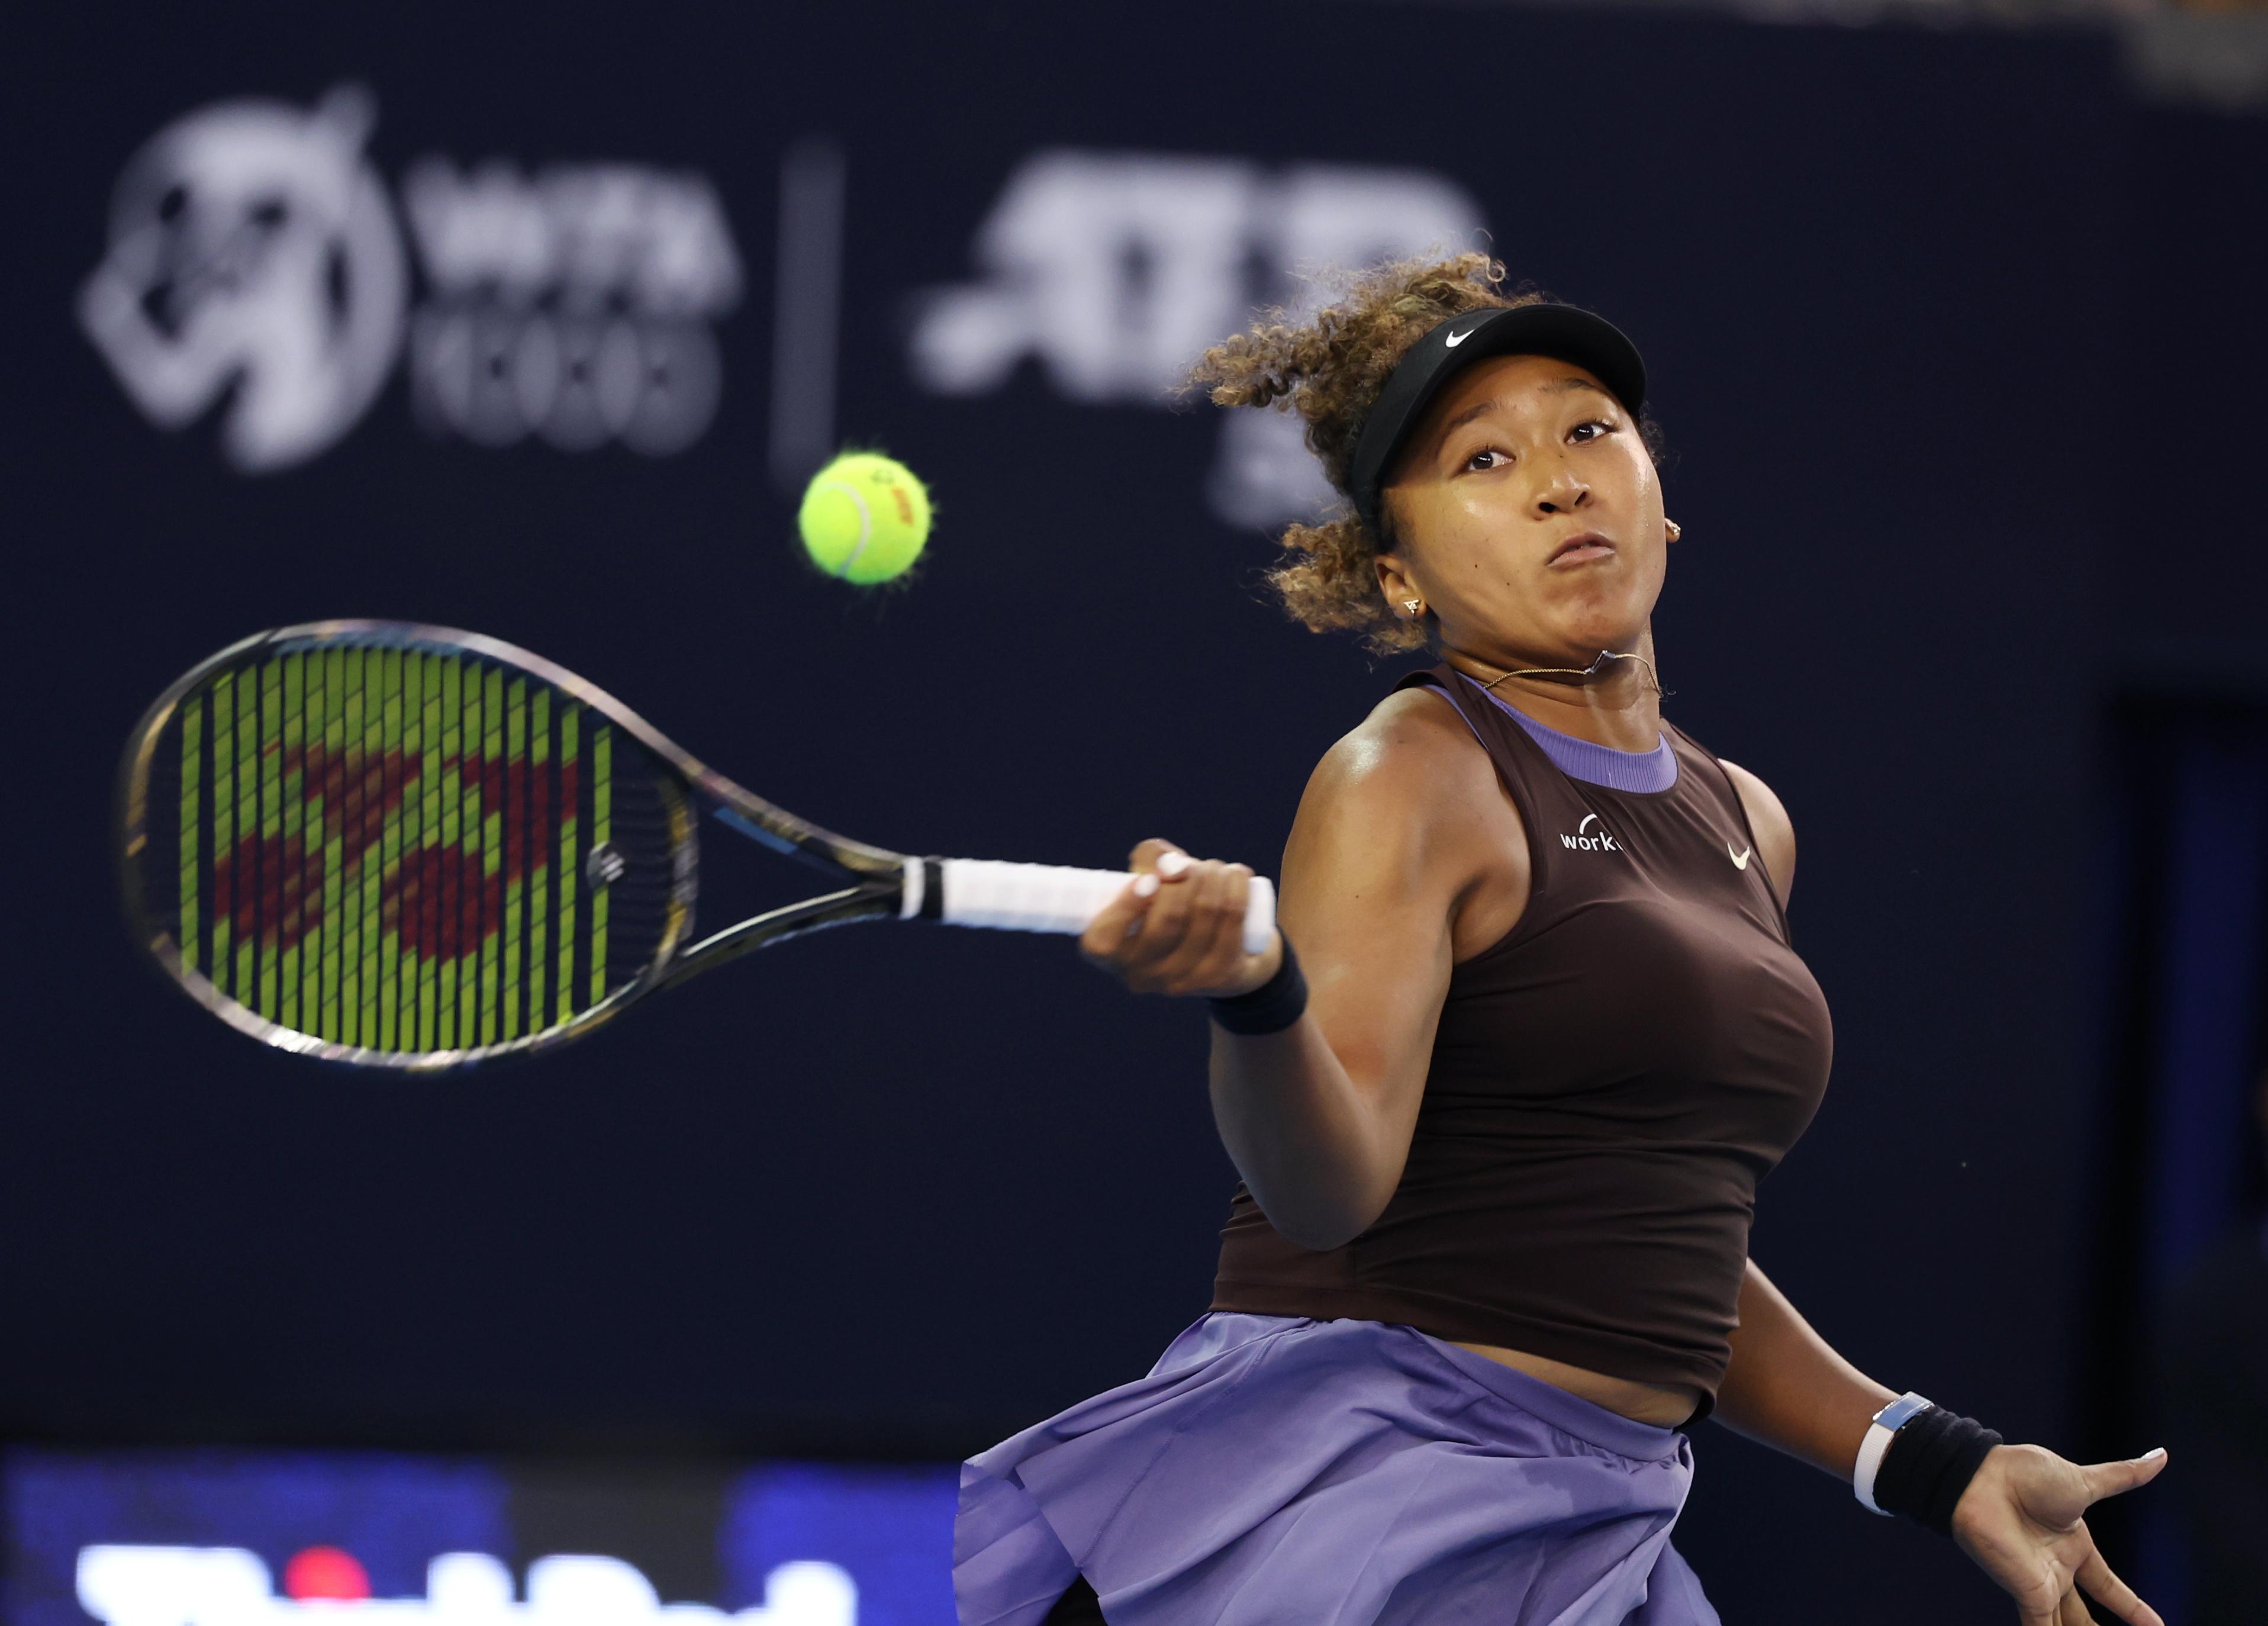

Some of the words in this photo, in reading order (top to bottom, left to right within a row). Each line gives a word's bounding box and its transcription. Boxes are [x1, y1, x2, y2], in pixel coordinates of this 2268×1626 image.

[405, 160, 741, 314] WTA
[410, 315, 721, 453] 1000
[1560, 831, 1623, 851] work
